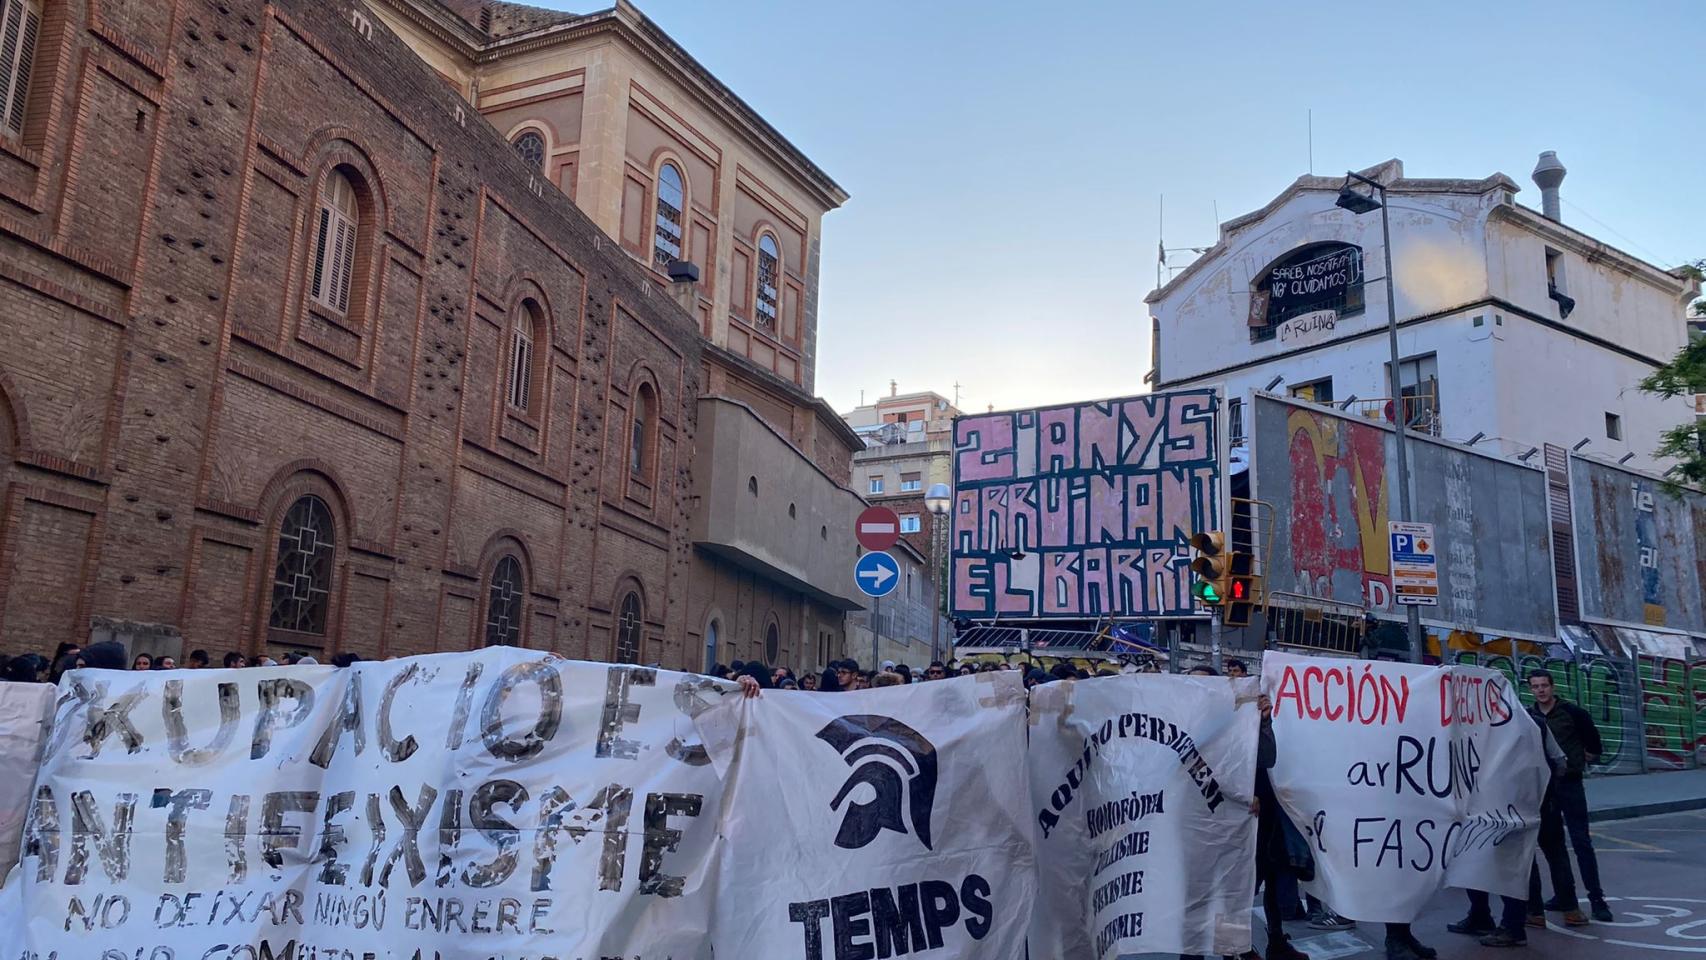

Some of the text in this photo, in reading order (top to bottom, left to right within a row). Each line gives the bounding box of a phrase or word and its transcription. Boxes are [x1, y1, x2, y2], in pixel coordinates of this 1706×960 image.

[1039, 393, 1213, 474] ANYS
[1396, 534, 1408, 551] P
[955, 556, 1034, 613] EL
[1089, 719, 1113, 757] NO
[64, 889, 555, 935] NO DEIXAR NINGÚ ENRERE
[788, 873, 994, 960] TEMPS
